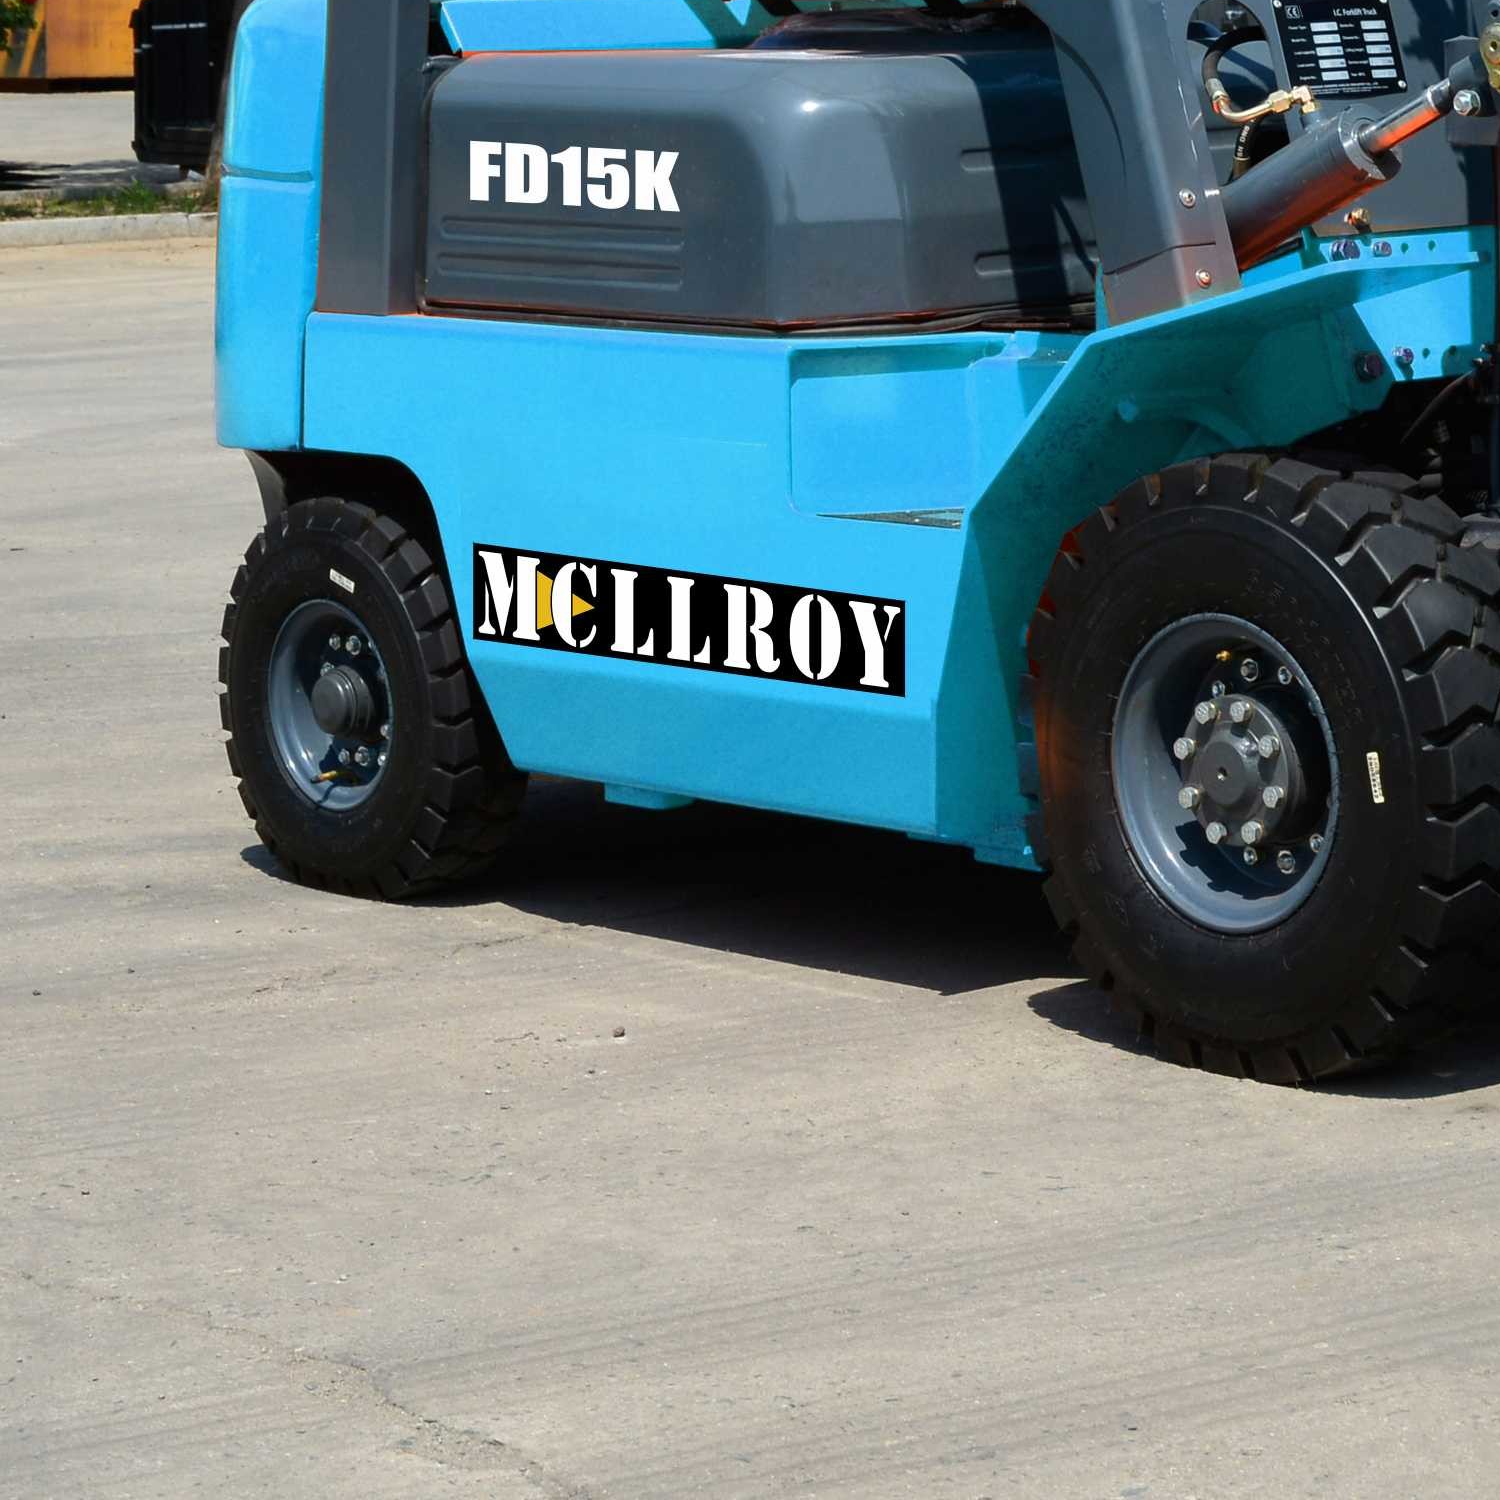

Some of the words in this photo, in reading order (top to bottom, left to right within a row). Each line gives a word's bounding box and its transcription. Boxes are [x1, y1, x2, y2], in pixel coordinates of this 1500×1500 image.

[1343, 7, 1361, 16] Forklift
[1361, 7, 1377, 16] Truck
[469, 140, 680, 212] FD15K
[478, 550, 901, 688] MCLLROY
